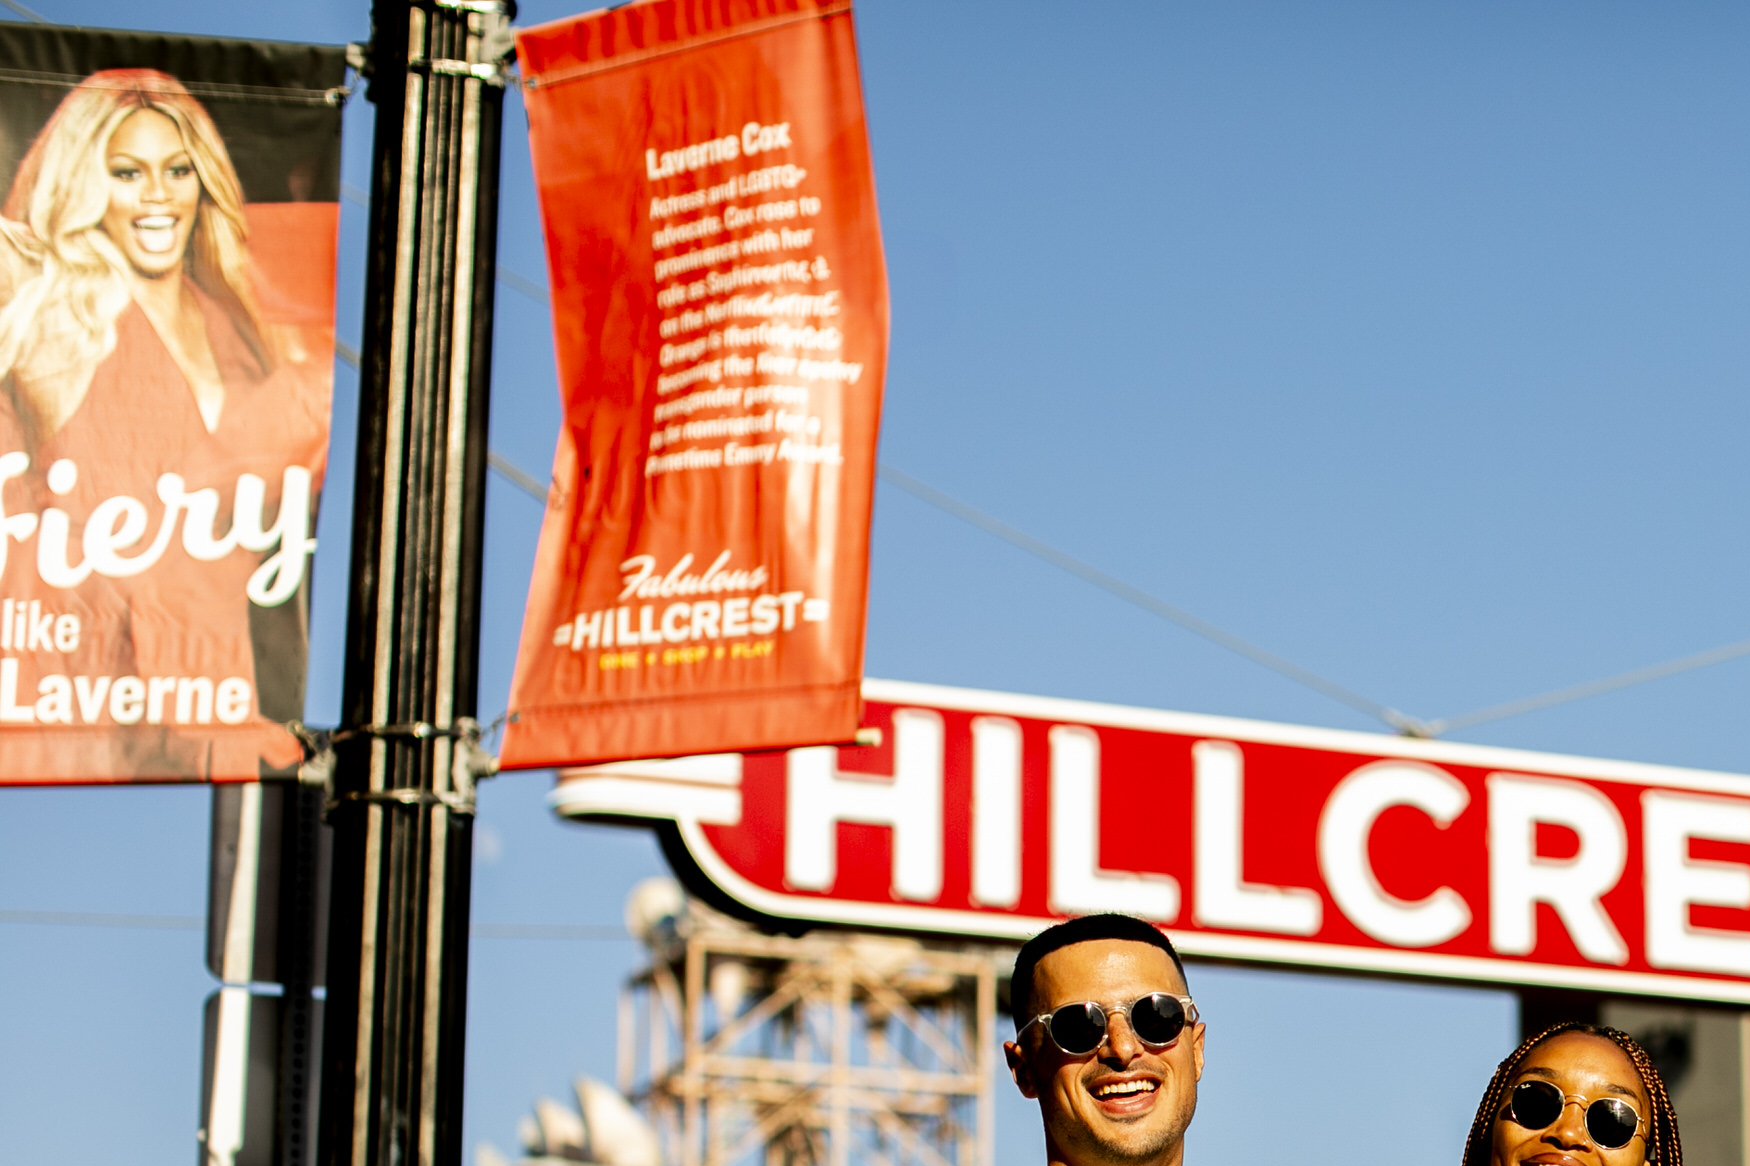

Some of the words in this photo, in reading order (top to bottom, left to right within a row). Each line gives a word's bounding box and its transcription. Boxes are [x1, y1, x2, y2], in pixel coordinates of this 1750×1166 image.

[646, 134, 740, 181] Laverne
[742, 121, 792, 157] Cox
[724, 205, 755, 230] Cox
[799, 196, 821, 217] to
[741, 228, 780, 256] with
[780, 226, 815, 250] her
[617, 549, 769, 602] Fabulous
[0, 598, 81, 653] like
[571, 590, 805, 651] HILLCREST
[0, 656, 251, 726] Laverne
